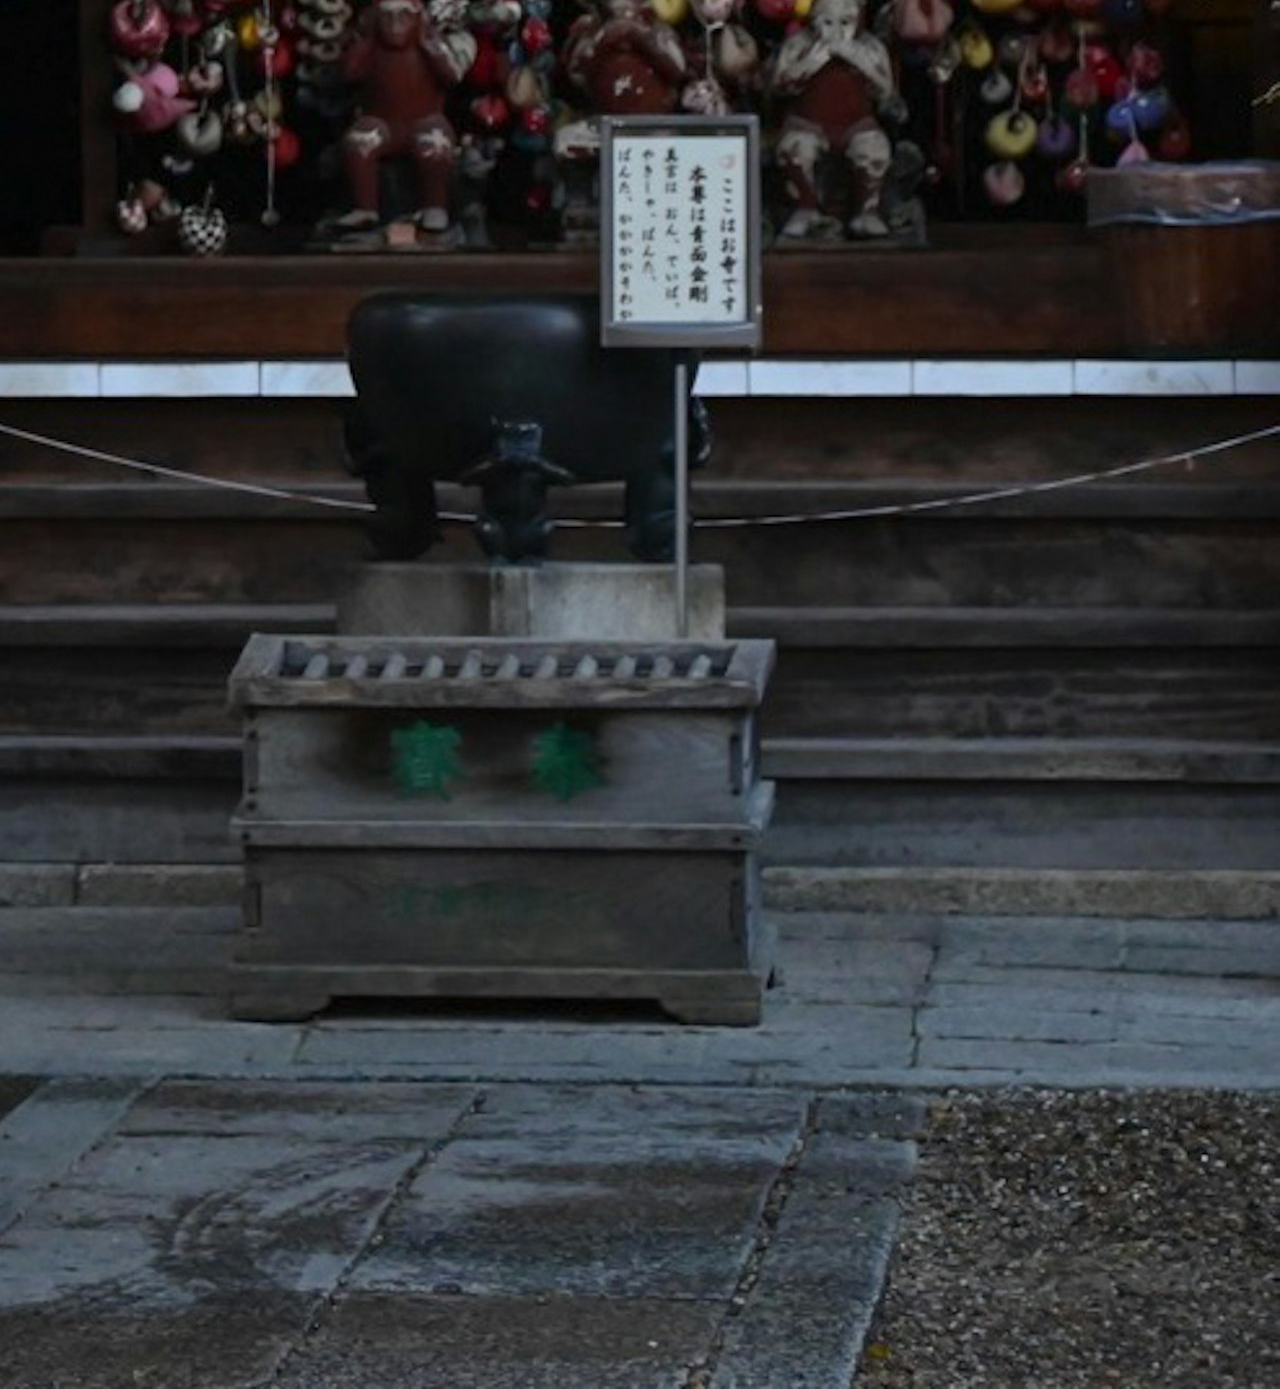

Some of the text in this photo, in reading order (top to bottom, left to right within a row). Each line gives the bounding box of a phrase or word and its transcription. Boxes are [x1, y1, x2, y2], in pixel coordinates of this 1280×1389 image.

[688, 165, 709, 304] 本尊は青面金剛
